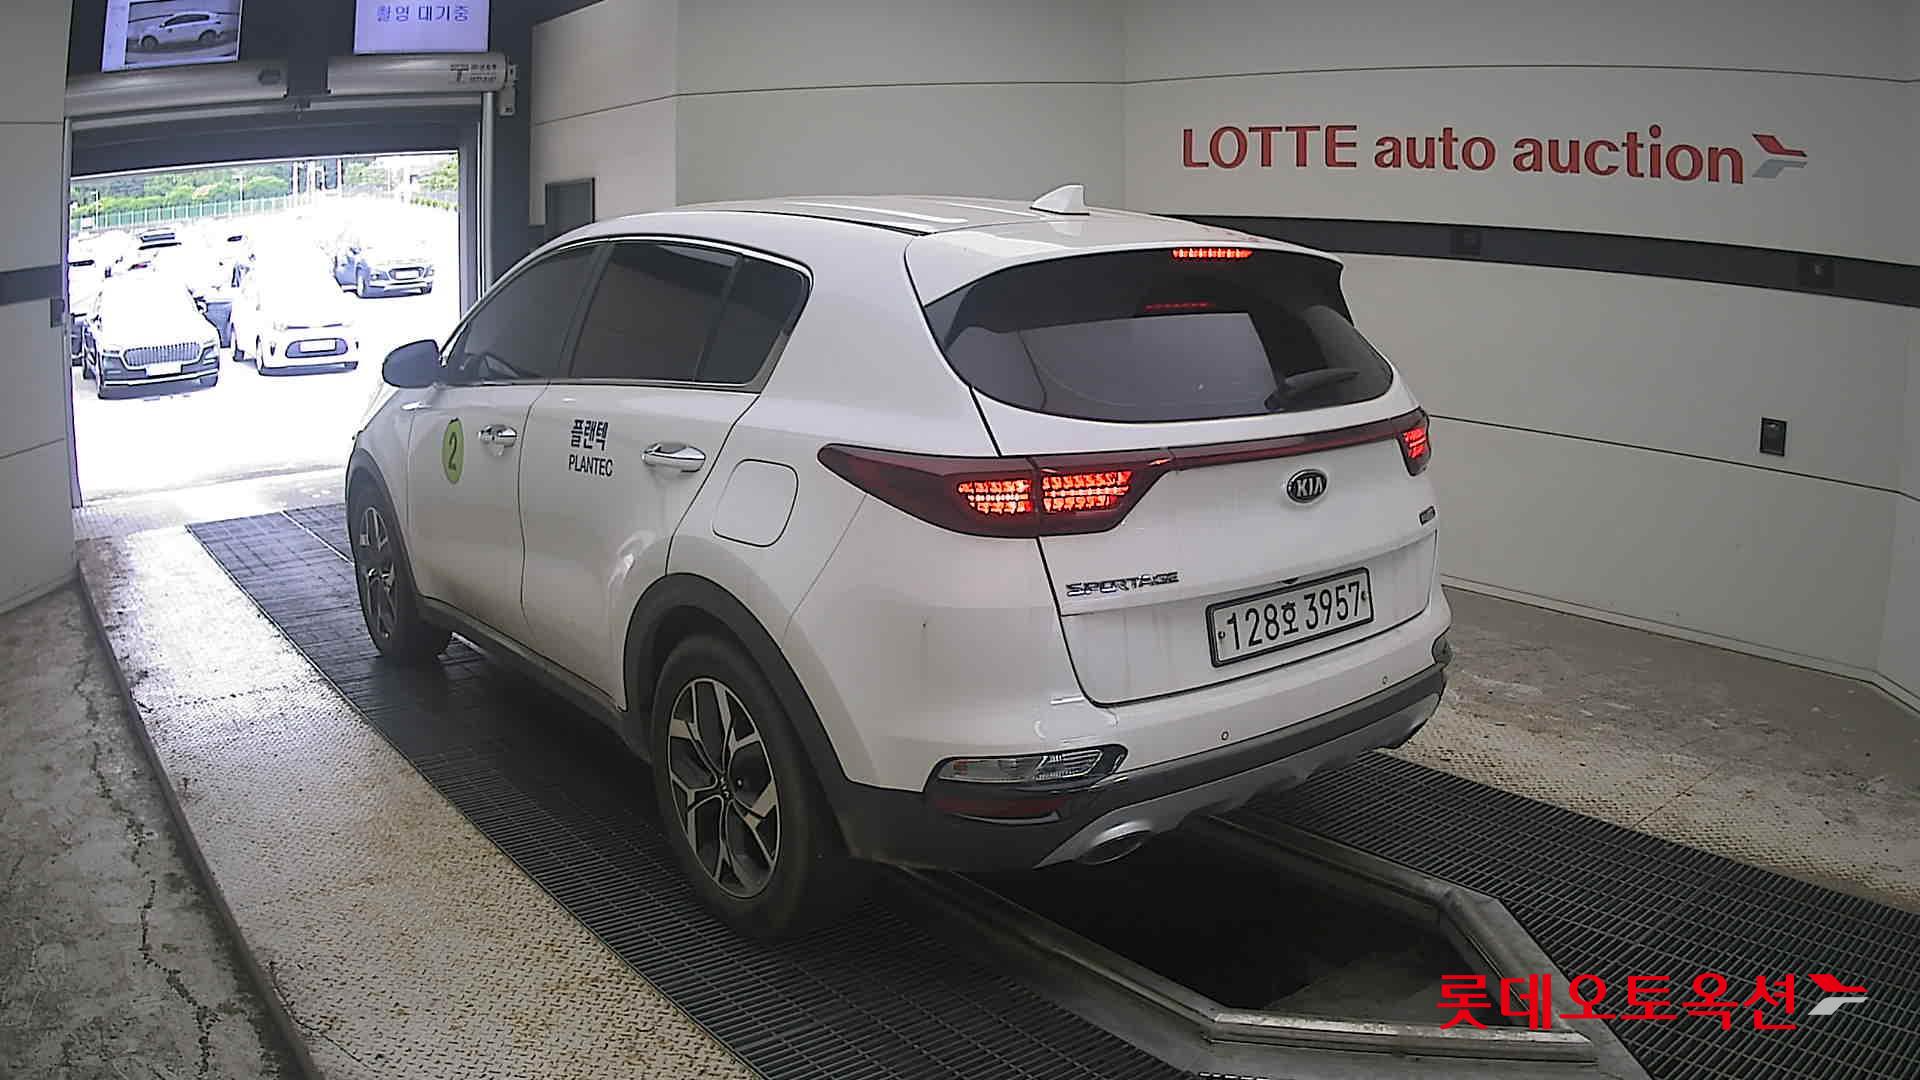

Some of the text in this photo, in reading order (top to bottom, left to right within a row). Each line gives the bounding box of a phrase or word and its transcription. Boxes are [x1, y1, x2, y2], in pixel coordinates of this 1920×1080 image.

[376, 5, 471, 22] 촬영 대기중
[1183, 124, 1744, 184] LOTTE auto auction
[570, 419, 609, 451] 플랜텍
[448, 431, 458, 471] 2
[568, 454, 613, 477] PLANTEC
[1295, 476, 1326, 498] KIA
[1065, 571, 1180, 597] SPORTAGE
[1226, 581, 1361, 650] 128호 3957
